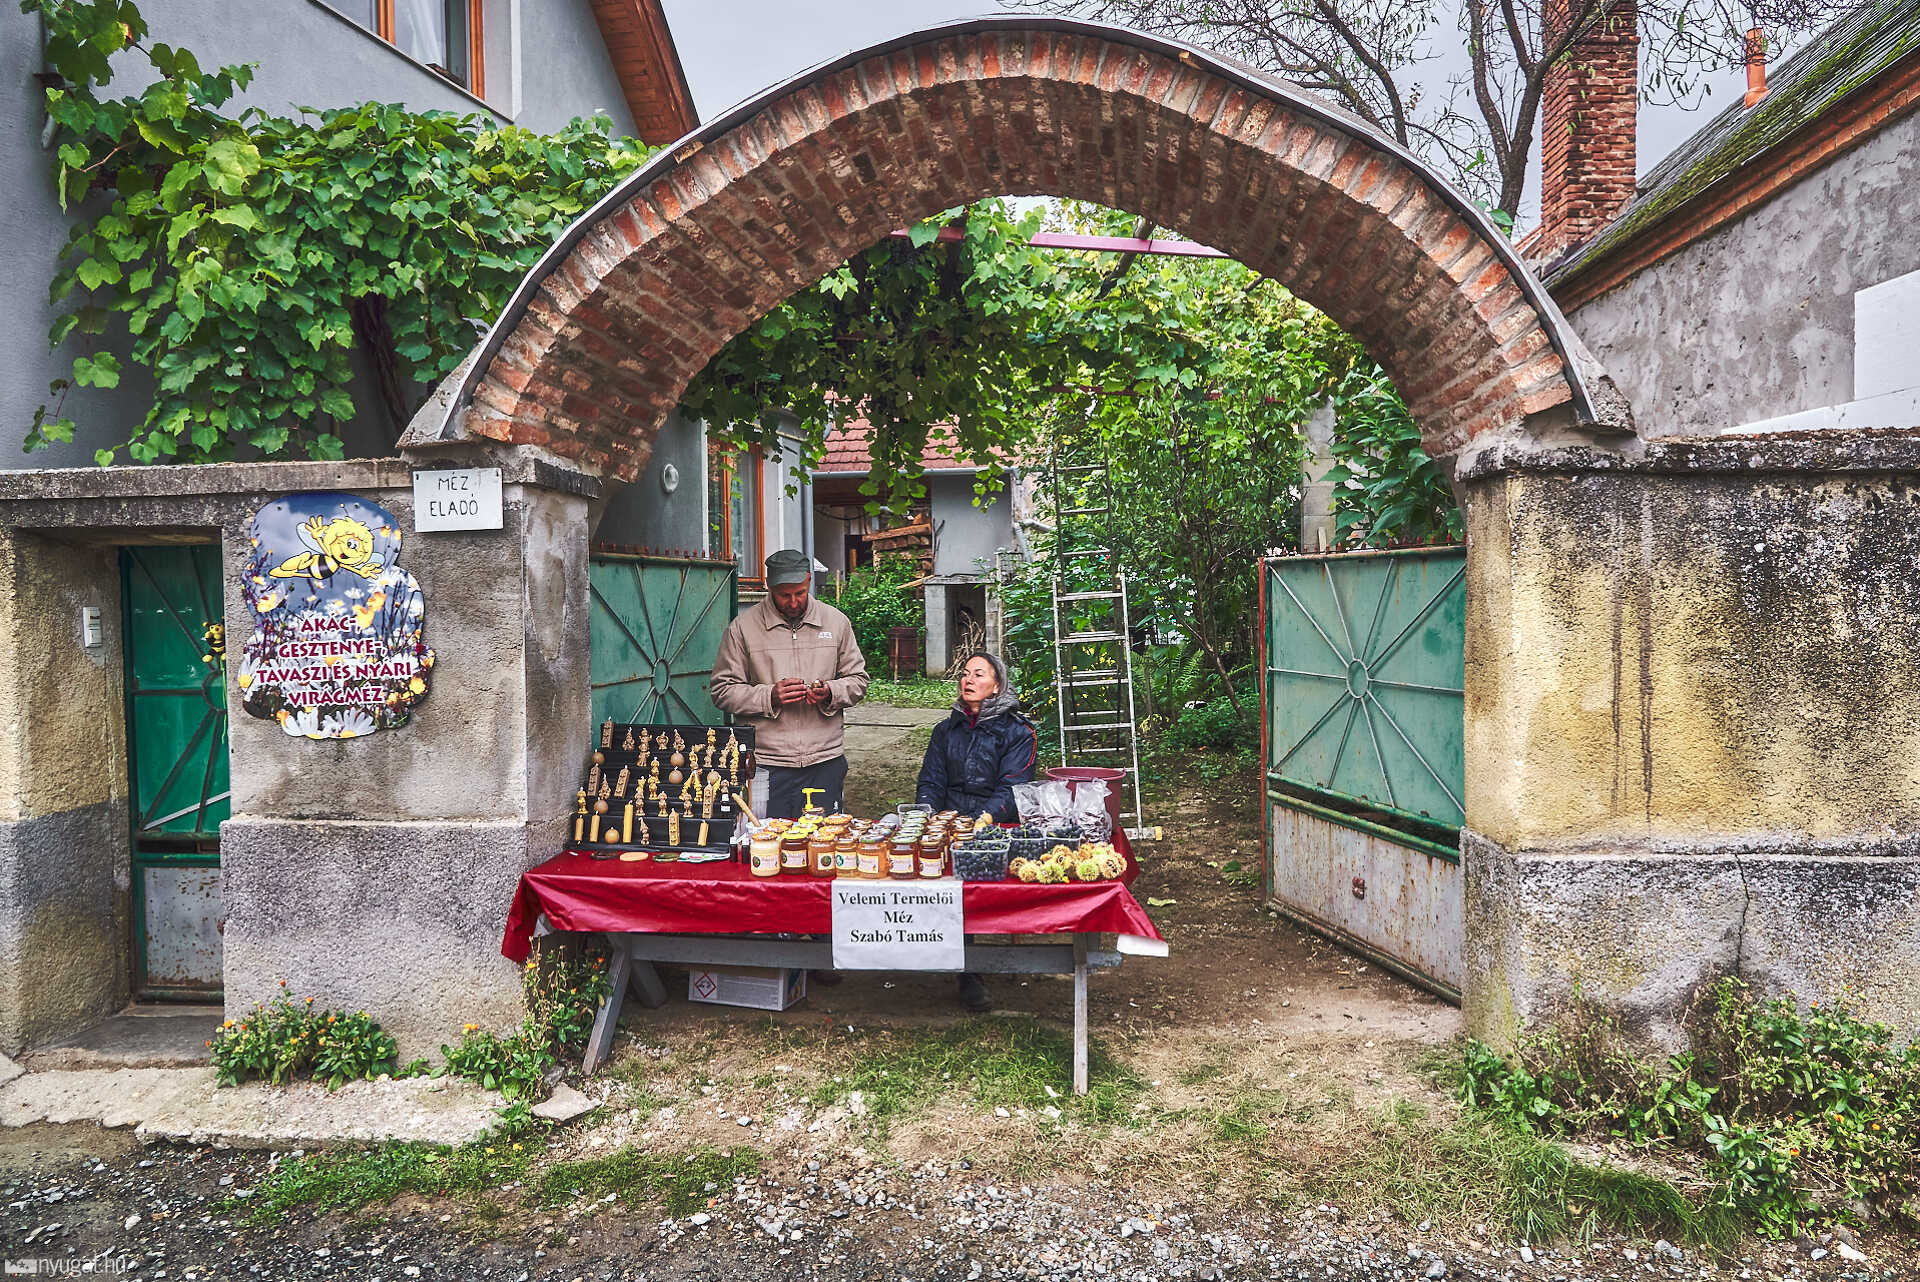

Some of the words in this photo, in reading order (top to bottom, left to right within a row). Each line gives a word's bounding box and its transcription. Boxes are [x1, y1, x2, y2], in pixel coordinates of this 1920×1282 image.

[438, 471, 469, 491] MÉZ
[429, 493, 479, 517] ELADÓ
[300, 613, 362, 634] AKÁC-,
[278, 639, 388, 659] GESZTENYE-,
[256, 666, 328, 684] TAVASZI
[333, 662, 351, 680] ÉS
[355, 658, 412, 678] NYÁRI
[288, 683, 384, 706] VIRÁGMÉZ
[838, 892, 887, 905] Velemi
[890, 892, 954, 905] Termelői
[884, 910, 913, 923] Méz
[850, 929, 892, 943] Szabó
[896, 929, 944, 943] Tamás
